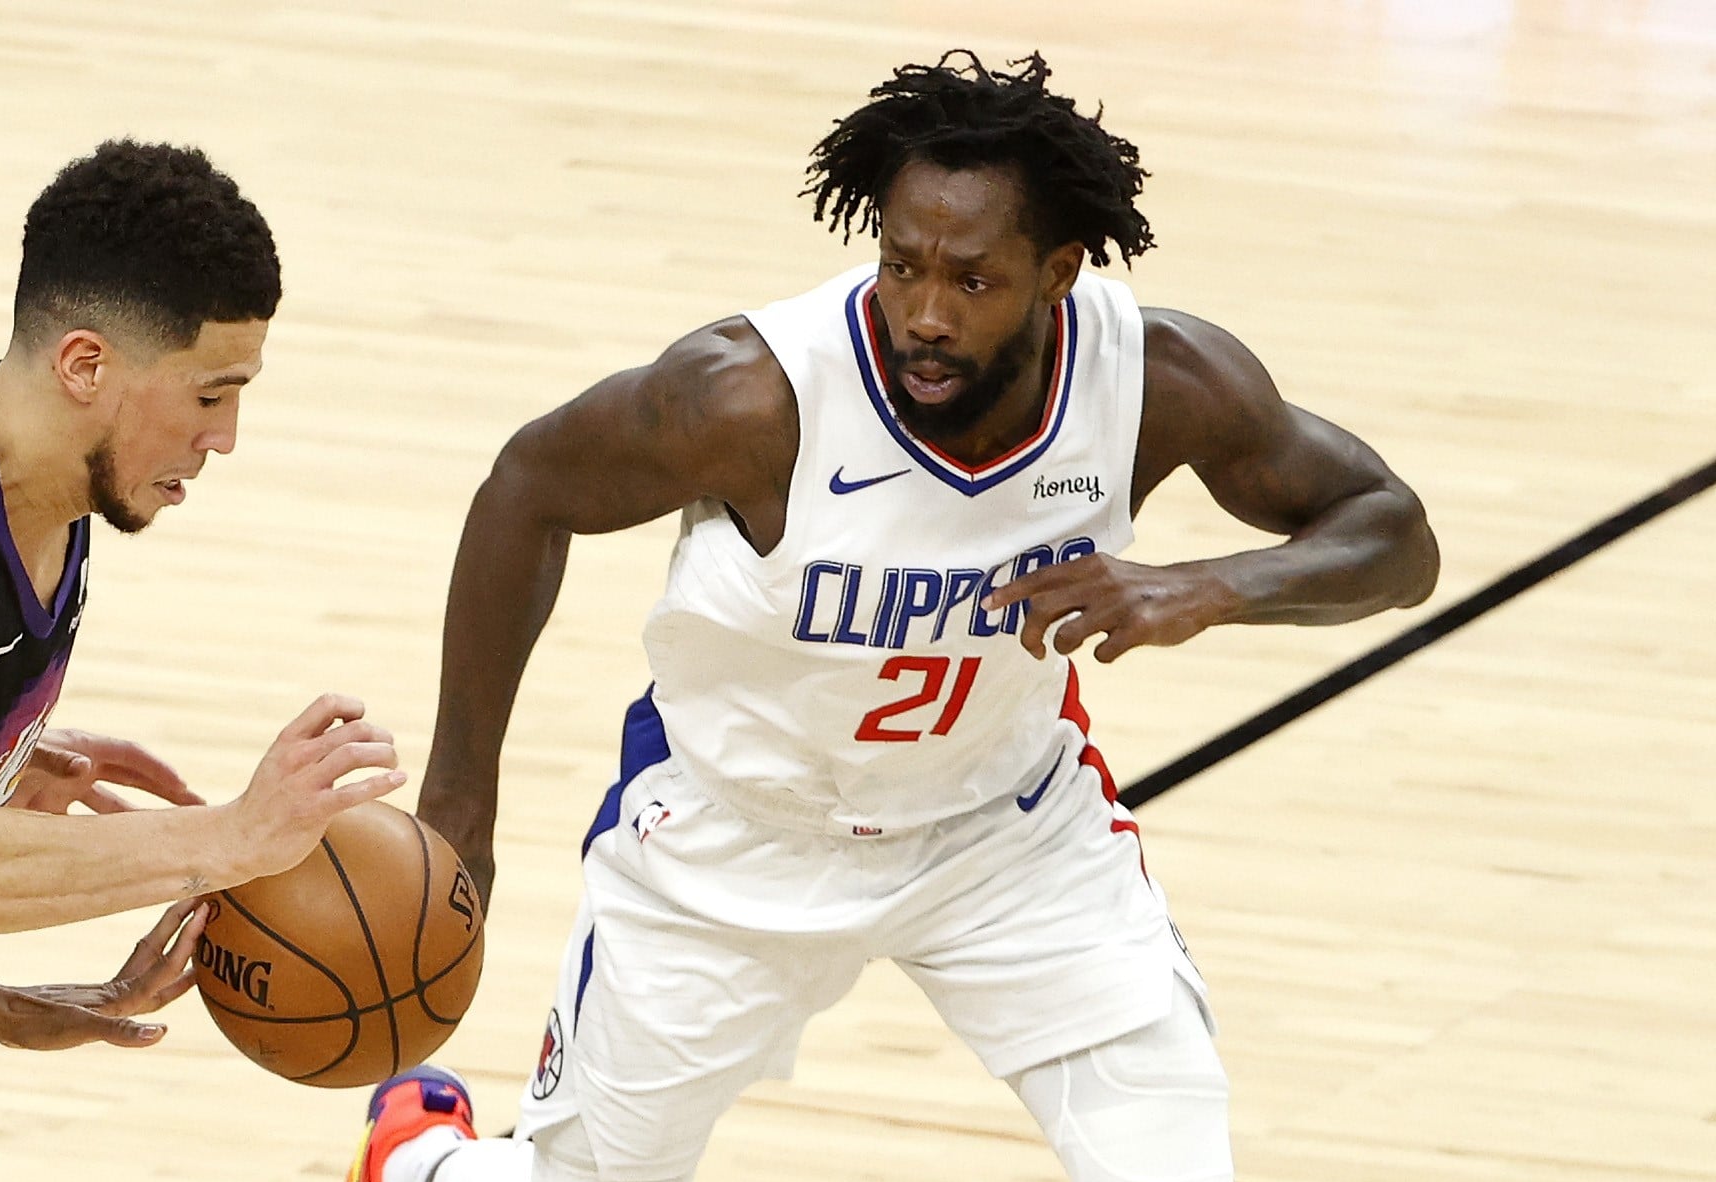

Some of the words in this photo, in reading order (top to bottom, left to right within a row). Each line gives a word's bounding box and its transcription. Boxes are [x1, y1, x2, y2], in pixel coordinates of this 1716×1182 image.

[1033, 475, 1105, 503] honey
[854, 655, 982, 743] 21
[196, 932, 272, 1009] DING
